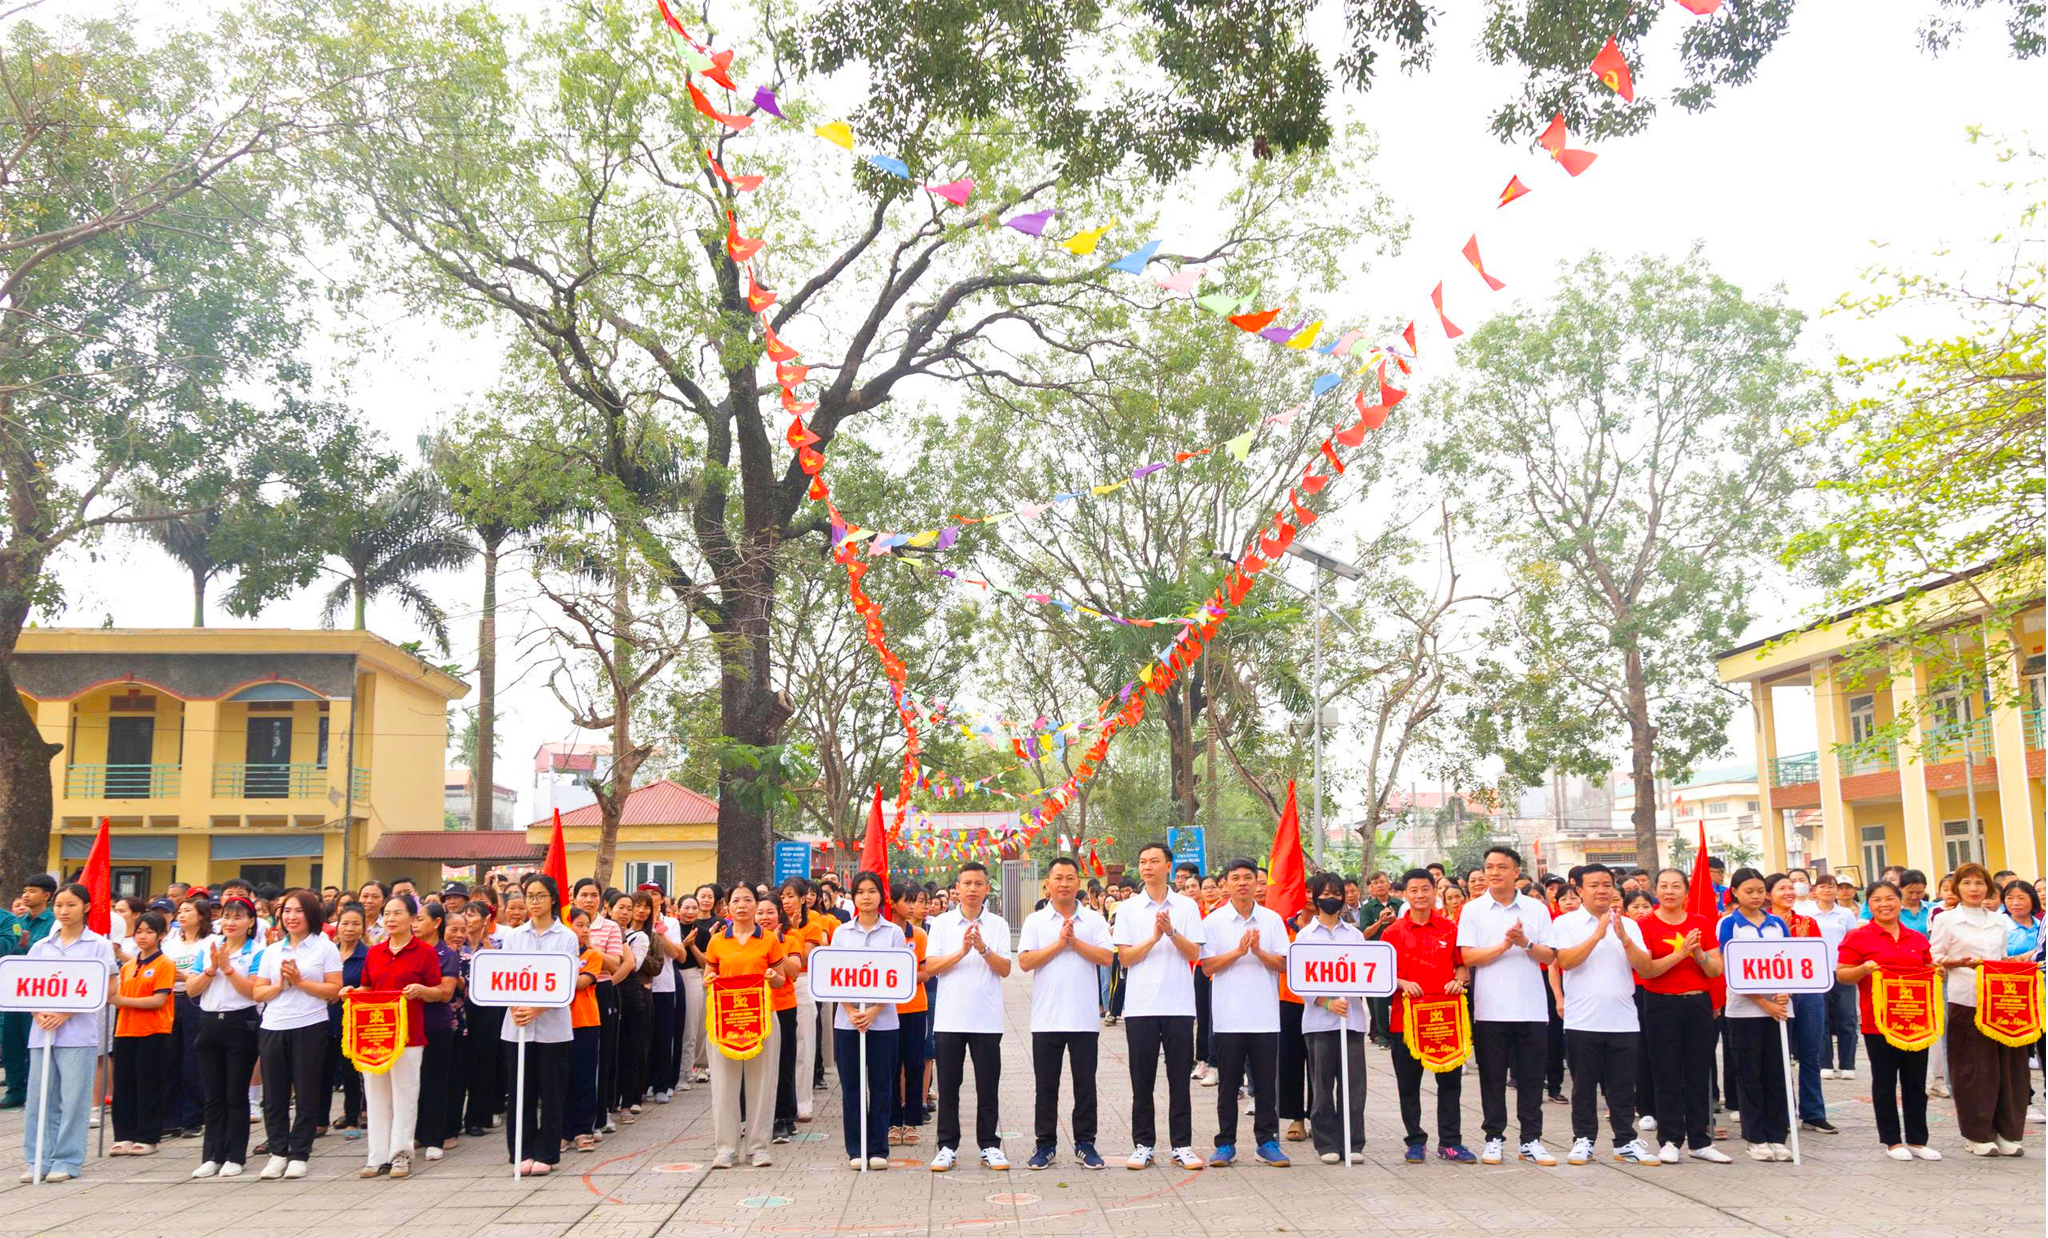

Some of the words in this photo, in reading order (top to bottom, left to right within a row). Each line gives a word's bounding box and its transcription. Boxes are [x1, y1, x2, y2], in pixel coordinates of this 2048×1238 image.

[491, 965, 537, 992] KHỐI
[544, 972, 557, 992] 5
[831, 961, 878, 988] KHỐI
[886, 969, 898, 988] 6
[1305, 954, 1356, 983] KHỐI
[1363, 961, 1377, 983] 7
[1743, 951, 1793, 980] KHỐI
[1800, 958, 1814, 980] 8
[16, 970, 68, 998] KHỐI
[74, 978, 88, 998] 4
